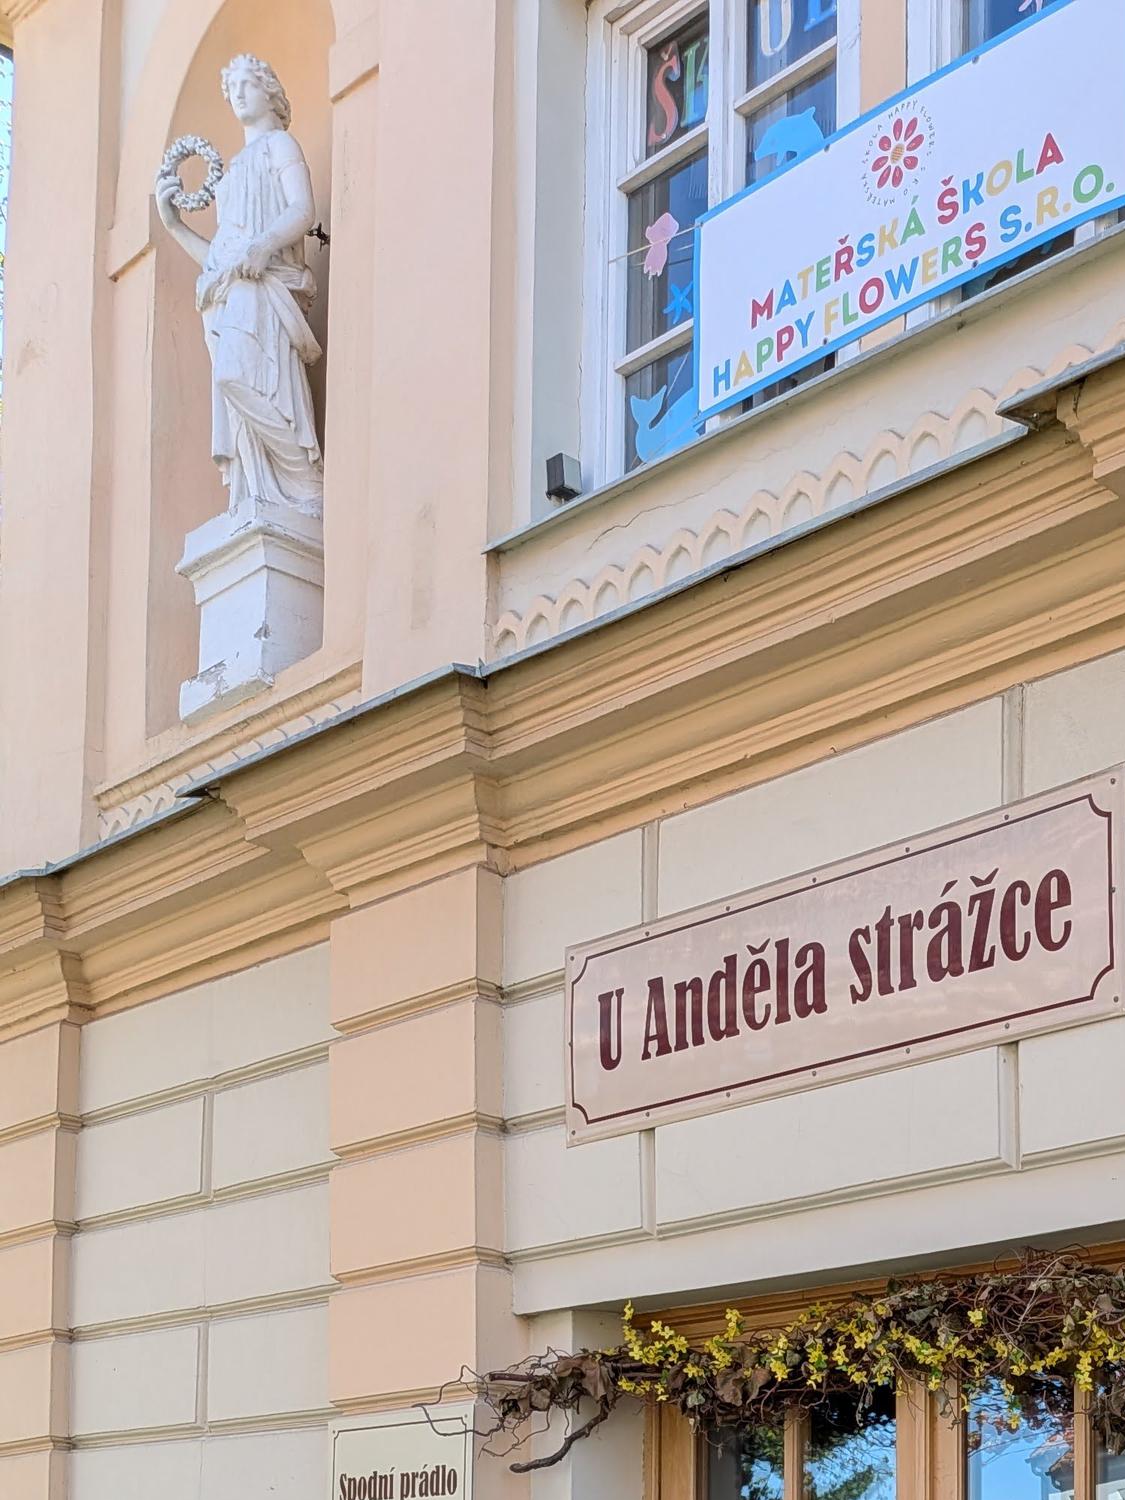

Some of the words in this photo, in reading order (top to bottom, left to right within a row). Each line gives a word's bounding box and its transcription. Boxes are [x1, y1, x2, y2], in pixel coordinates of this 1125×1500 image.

[713, 310, 815, 398] HAPPY
[822, 222, 987, 336] FLOWERS
[999, 165, 1115, 245] S.R.O.
[751, 198, 925, 330] MATEŘSKÁ
[937, 132, 1064, 225] ŠKOLA
[598, 987, 625, 1071] U
[641, 936, 829, 1062] Anděla
[848, 867, 1073, 1005] strážce
